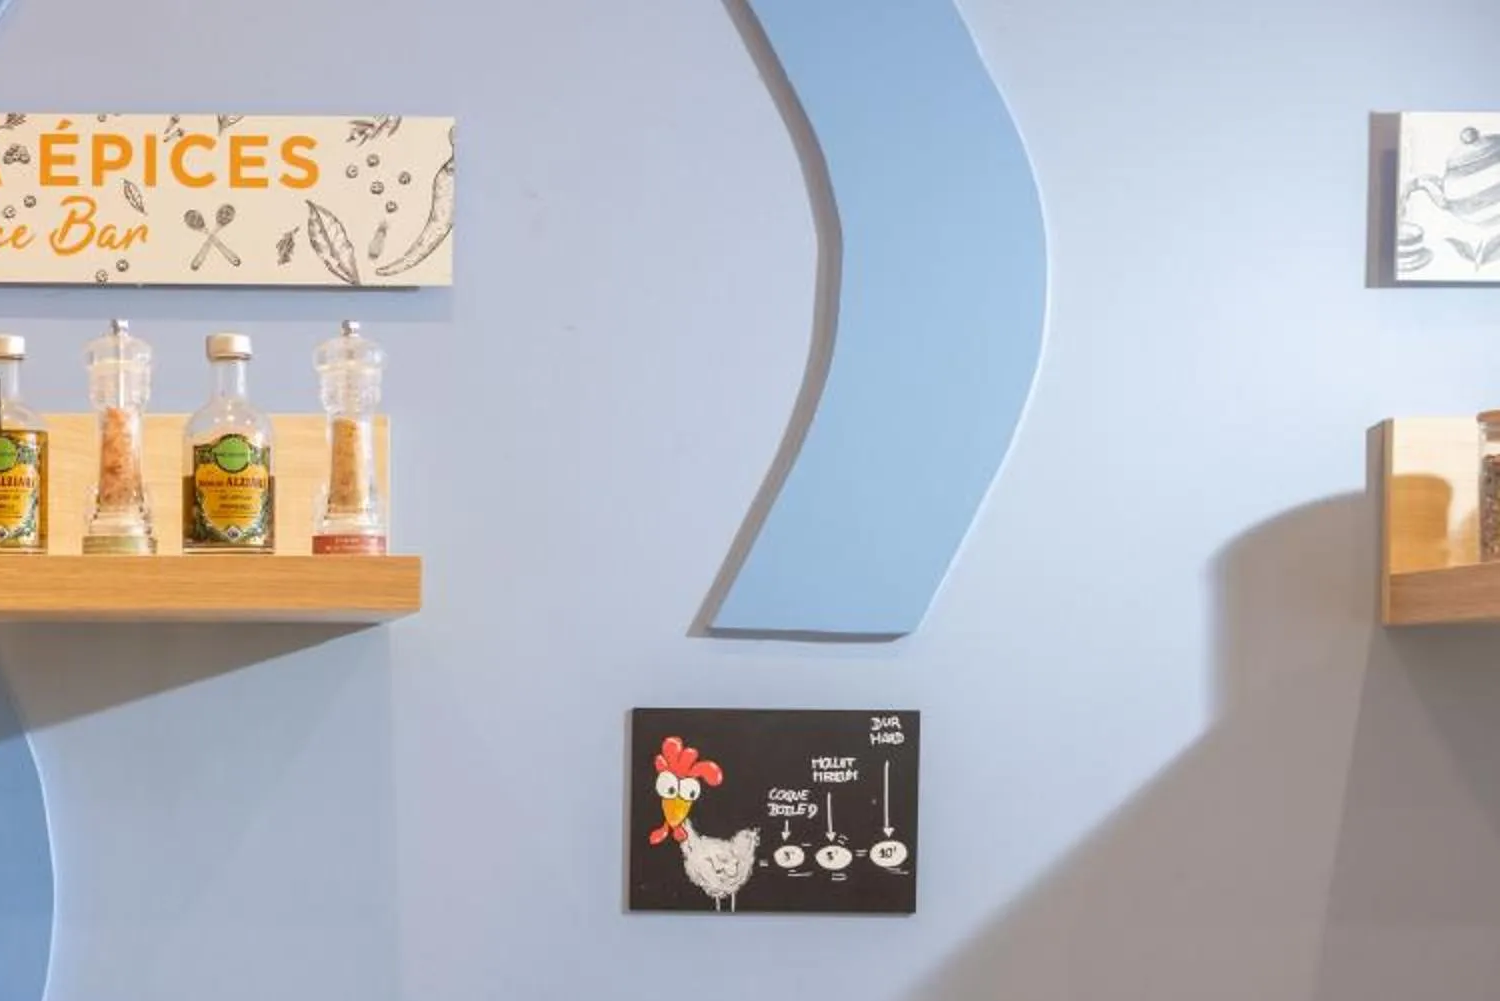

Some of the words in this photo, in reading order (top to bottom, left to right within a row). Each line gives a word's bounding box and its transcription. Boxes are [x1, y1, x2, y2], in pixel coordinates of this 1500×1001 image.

[39, 120, 319, 189] ÉPICES
[49, 196, 148, 256] Bar
[870, 716, 902, 731] DUR
[870, 731, 905, 746] HARD
[768, 788, 809, 802] COQUE
